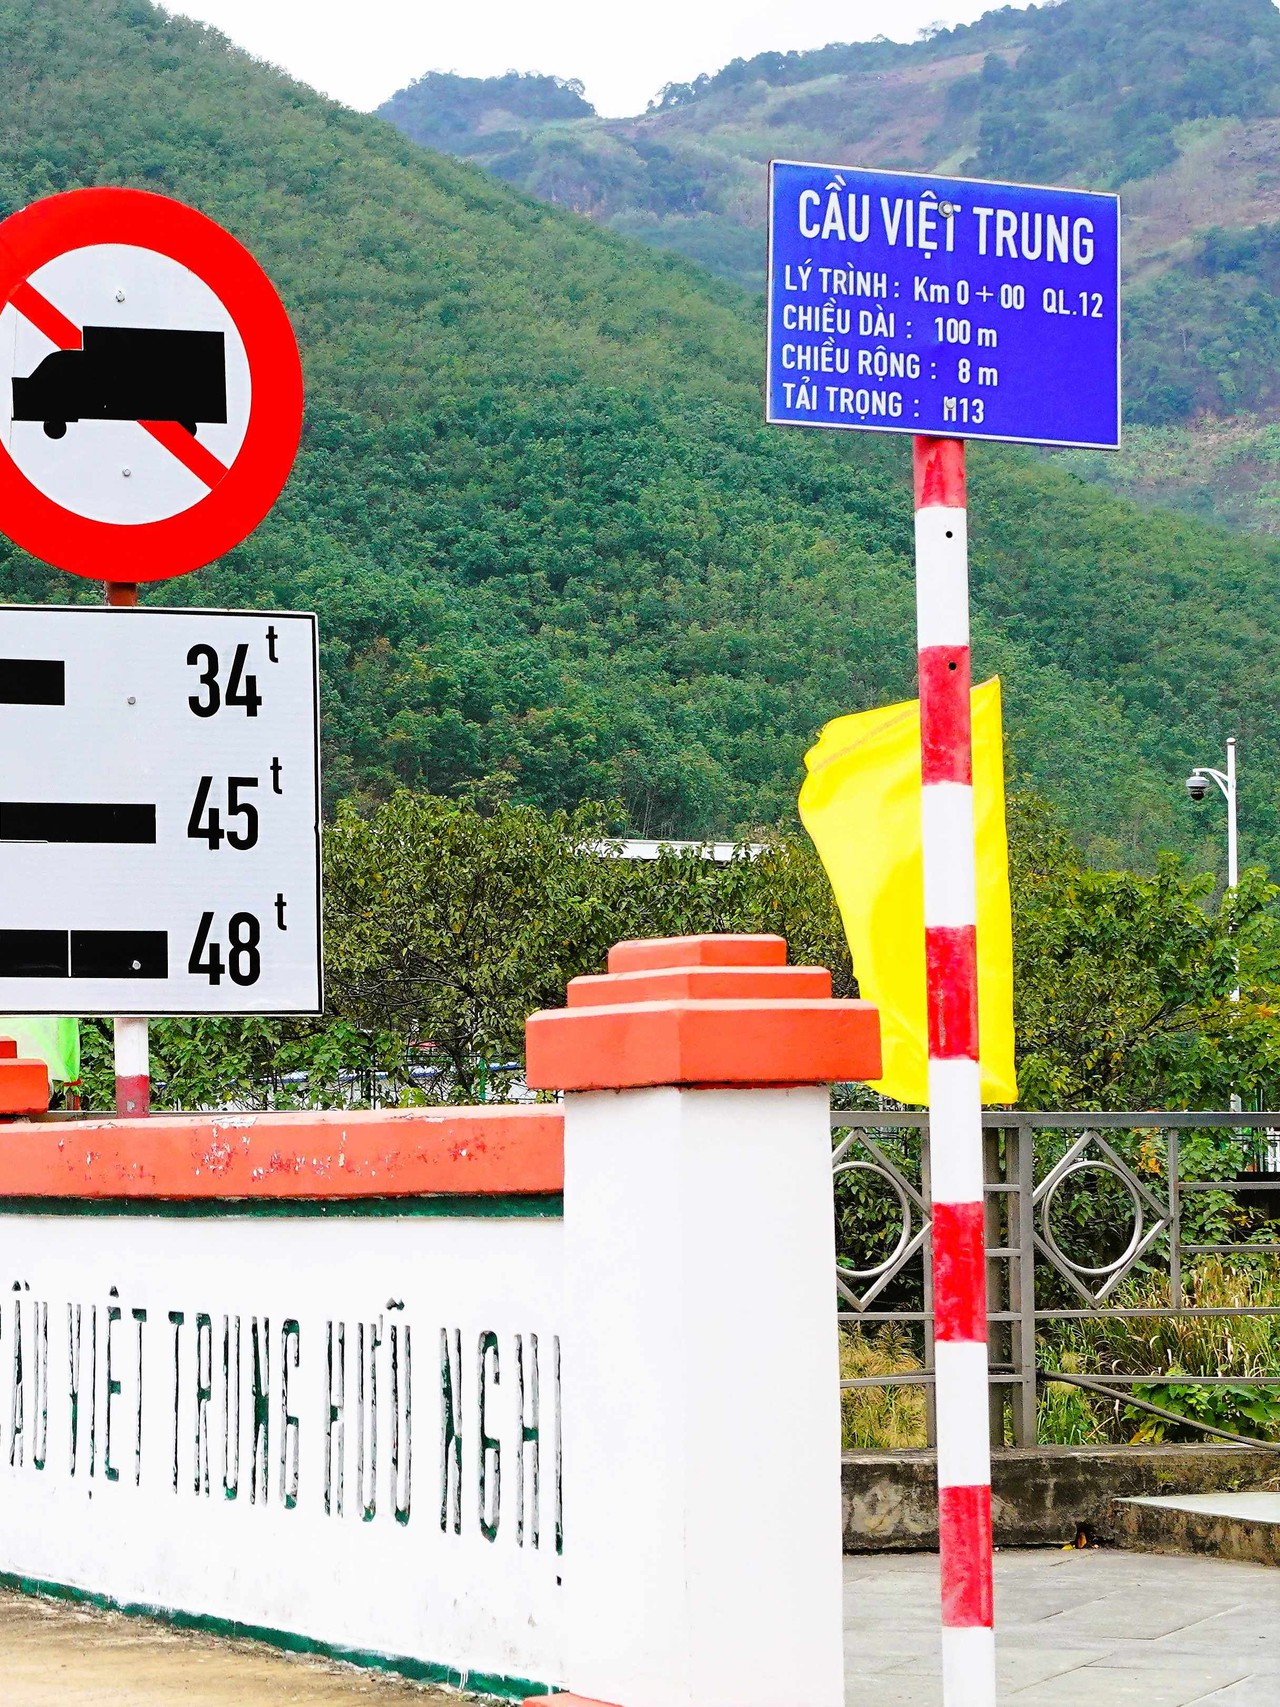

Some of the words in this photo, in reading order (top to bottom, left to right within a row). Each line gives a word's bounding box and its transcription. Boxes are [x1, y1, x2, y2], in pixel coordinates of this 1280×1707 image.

[799, 174, 870, 243] CẦU
[880, 190, 962, 260] VIỆT
[972, 206, 1095, 266] TRUNG
[784, 258, 813, 292] LÝ
[818, 261, 888, 299] TRÌNH
[914, 276, 950, 304] Km
[1000, 283, 1025, 310] 00
[1042, 287, 1104, 318] QL.12
[783, 297, 851, 335] CHIỀU
[859, 303, 895, 338] DÀI
[934, 316, 971, 345] 100
[977, 327, 998, 348] m
[782, 336, 850, 374] CHIỀU
[858, 345, 921, 382] RỘNG
[958, 358, 971, 384] 8
[978, 366, 998, 387] m
[782, 375, 818, 411] TẢI
[825, 386, 902, 420] TRỌNG
[168, 1311, 301, 1510] TRUNG
